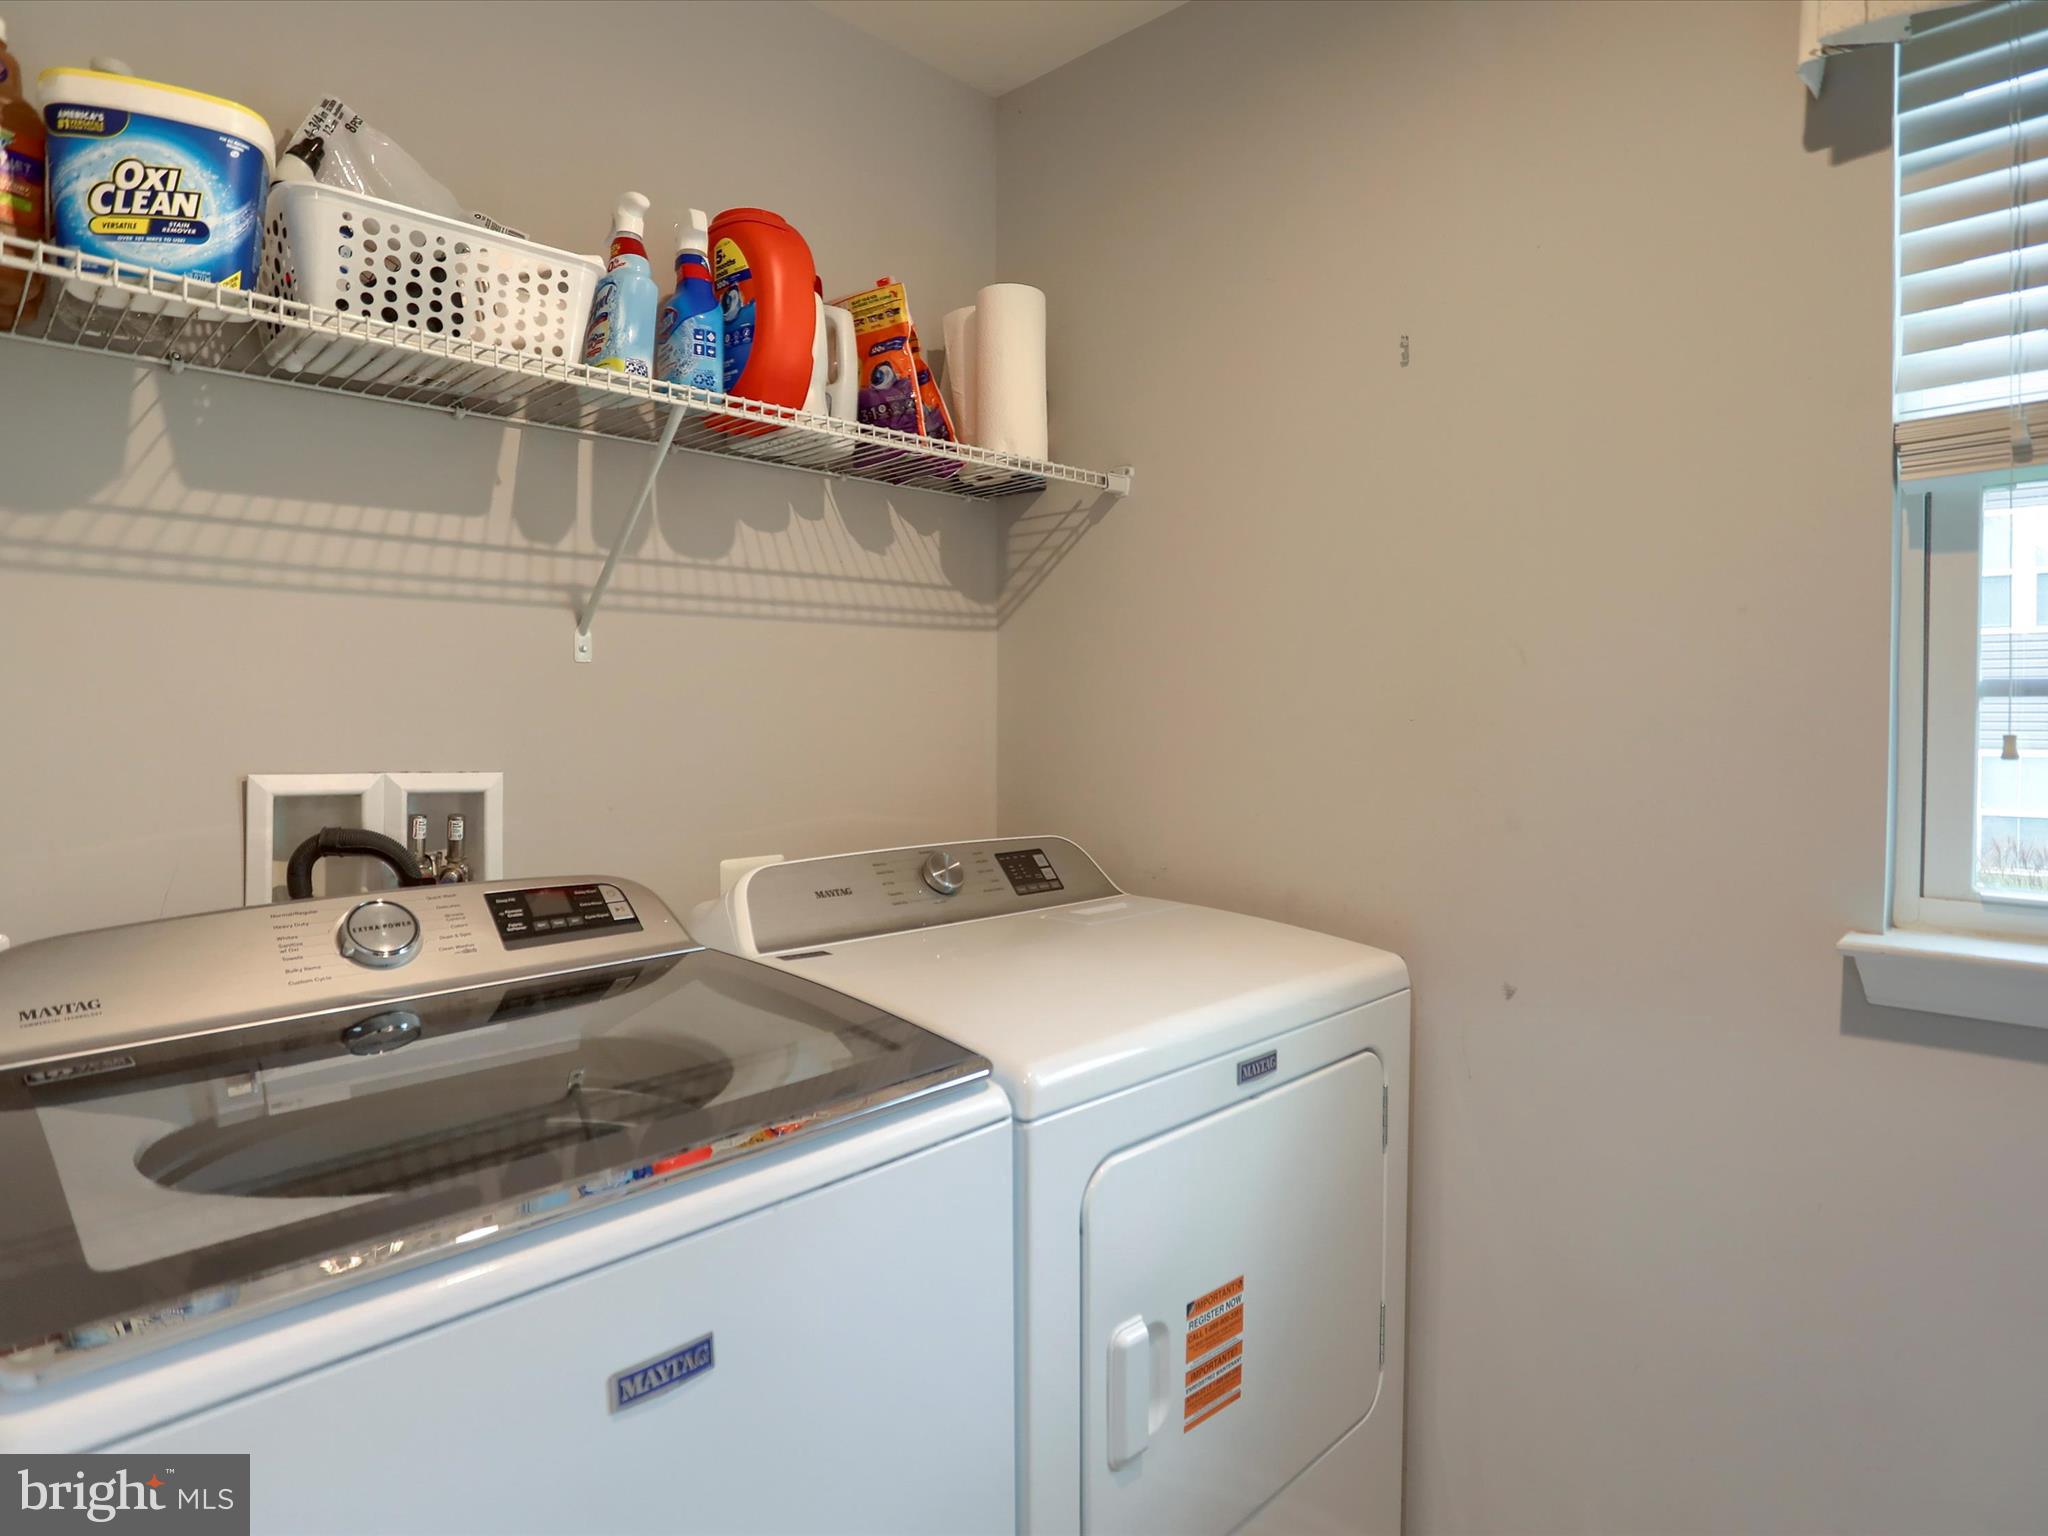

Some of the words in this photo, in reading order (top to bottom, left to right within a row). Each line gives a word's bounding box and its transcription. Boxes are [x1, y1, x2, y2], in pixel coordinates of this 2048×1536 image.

[113, 158, 182, 192] OXI
[88, 182, 201, 218] CLEAN
[161, 227, 196, 235] REMOVER
[168, 220, 190, 228] STAIN
[814, 887, 853, 899] MAYTAG
[352, 924, 381, 933] EXTRA
[382, 920, 412, 929] POWER
[19, 999, 101, 1021] MAYTAG
[1242, 1055, 1276, 1079] MAYTAG
[1188, 1303, 1225, 1331] REGISTER
[1225, 1293, 1243, 1311] NOW
[620, 1343, 710, 1402] MAYTAG
